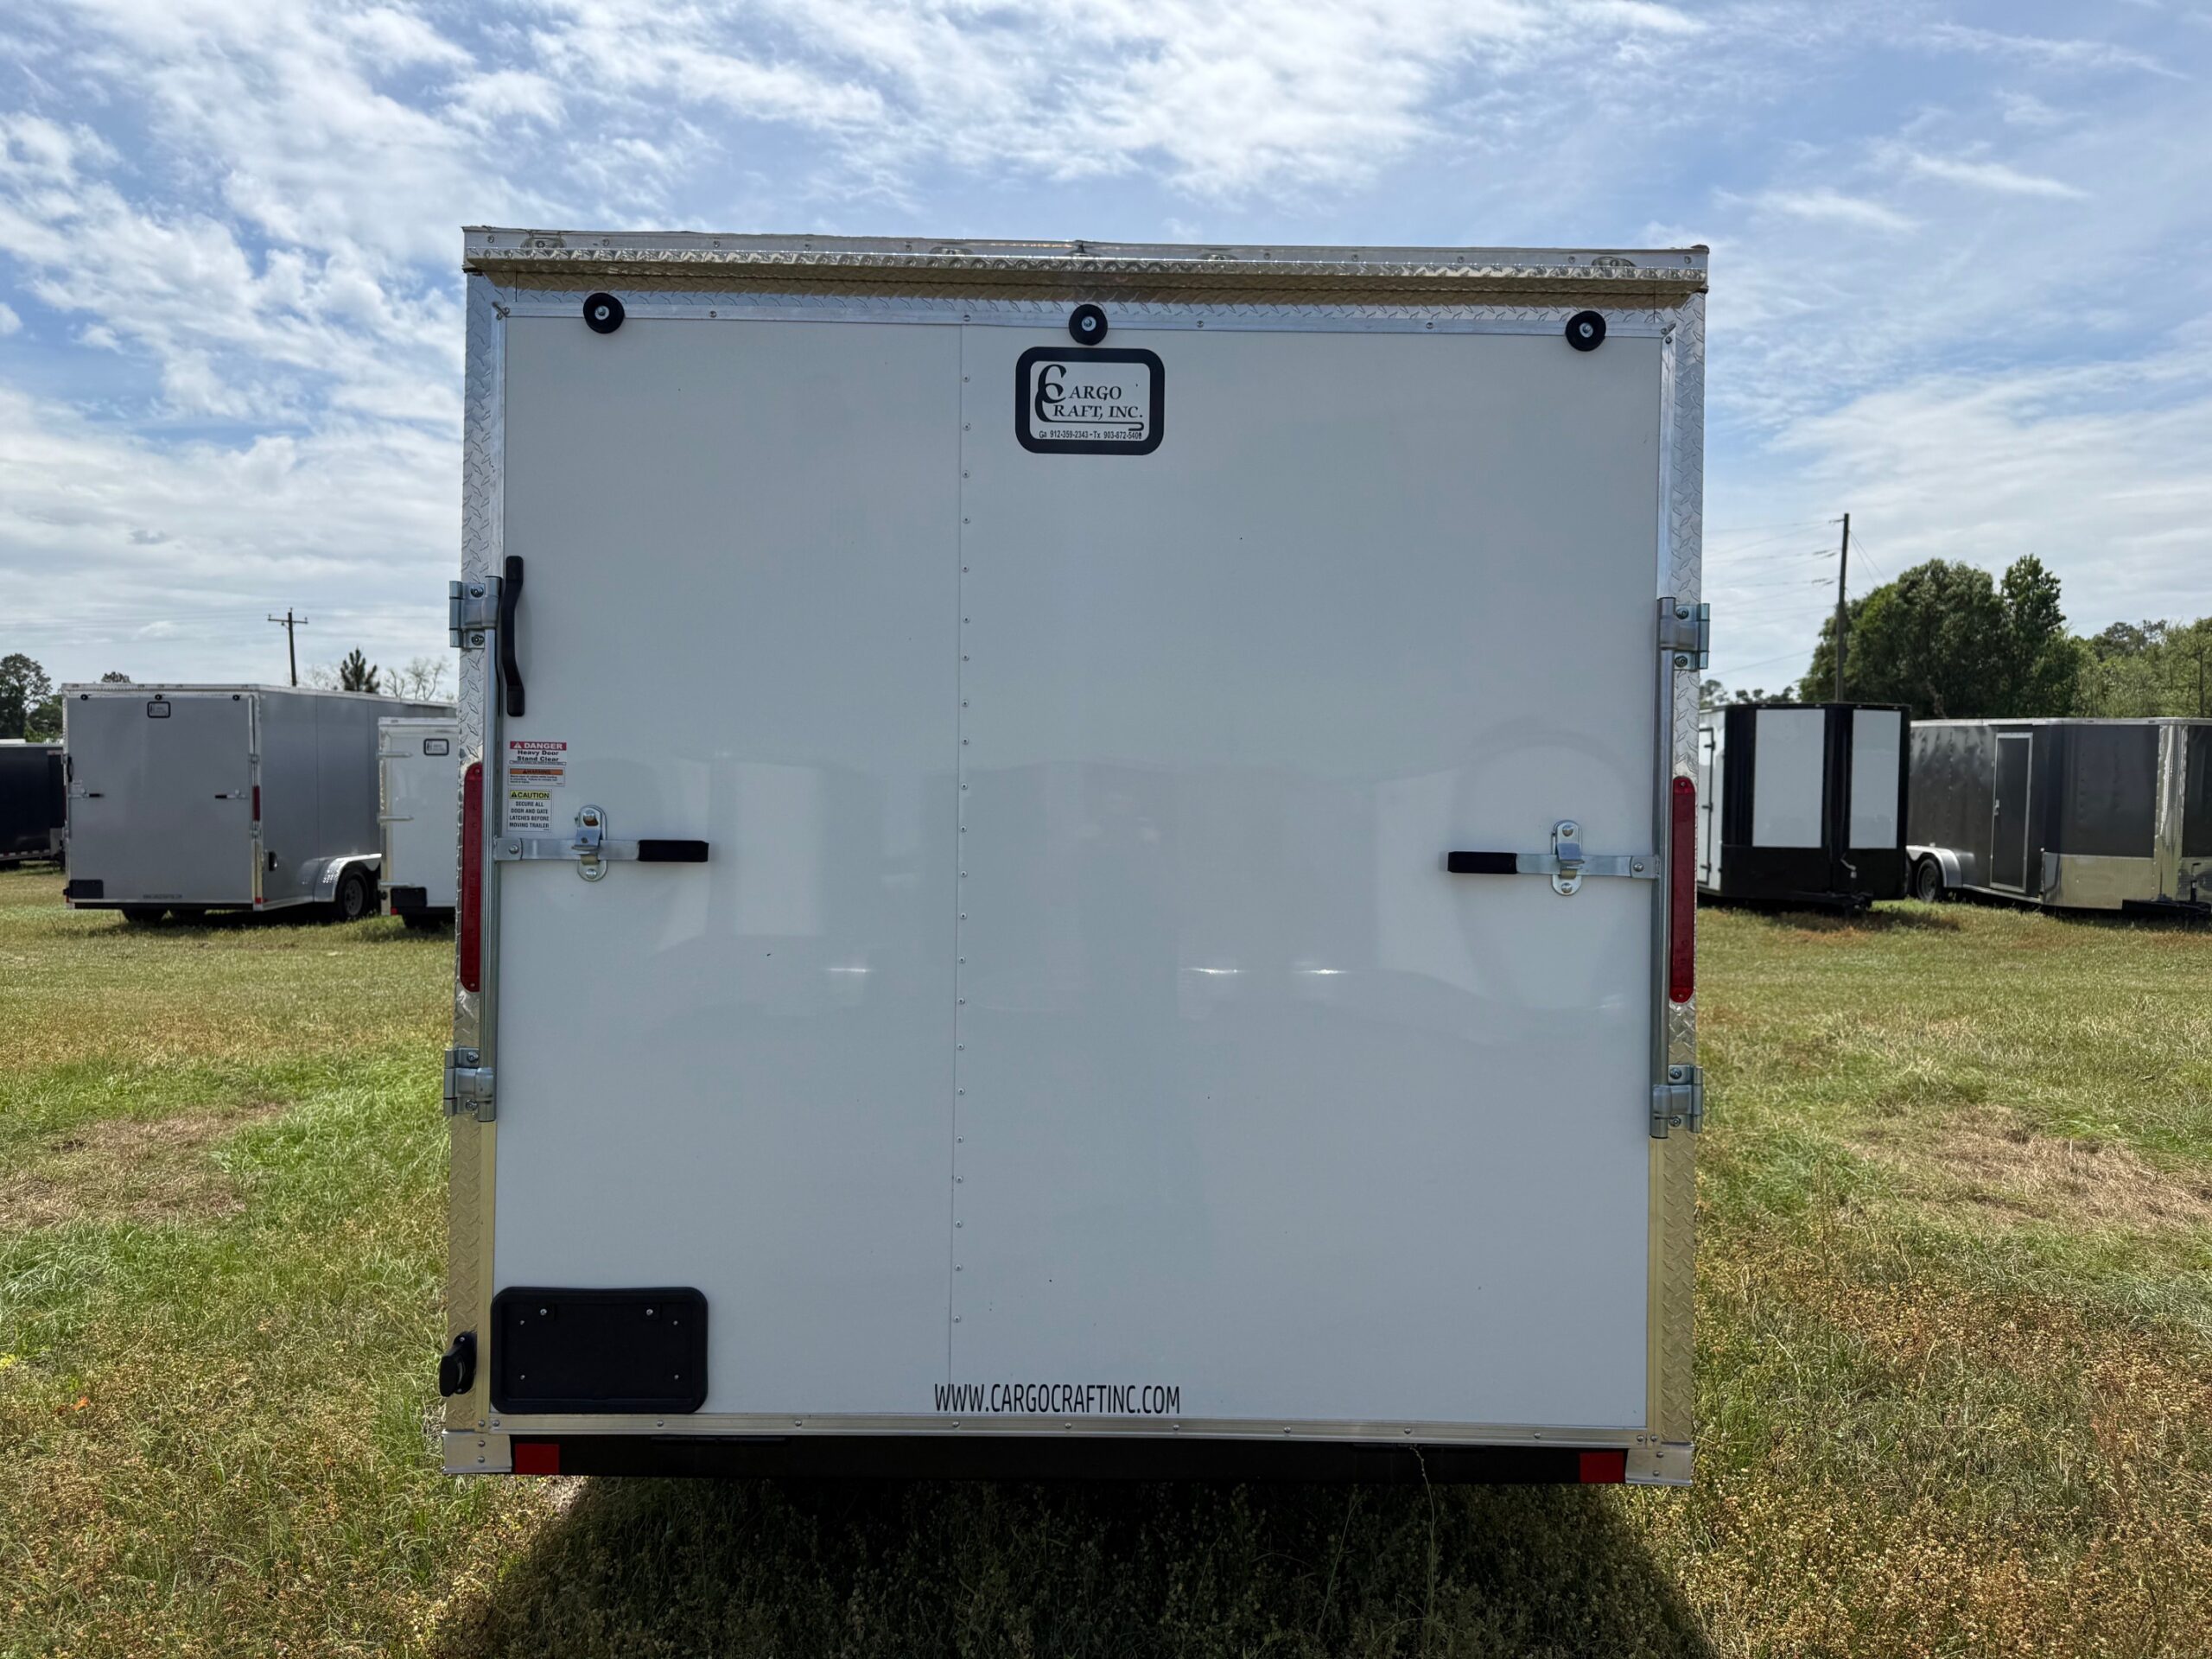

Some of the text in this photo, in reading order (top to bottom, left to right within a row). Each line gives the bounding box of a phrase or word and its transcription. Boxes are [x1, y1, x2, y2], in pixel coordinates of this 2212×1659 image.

[1038, 364, 1122, 404] CARGO
[1108, 405, 1143, 418] INC.
[934, 1383, 1180, 1414] WWW.CARGOCRAFTINC.COM
